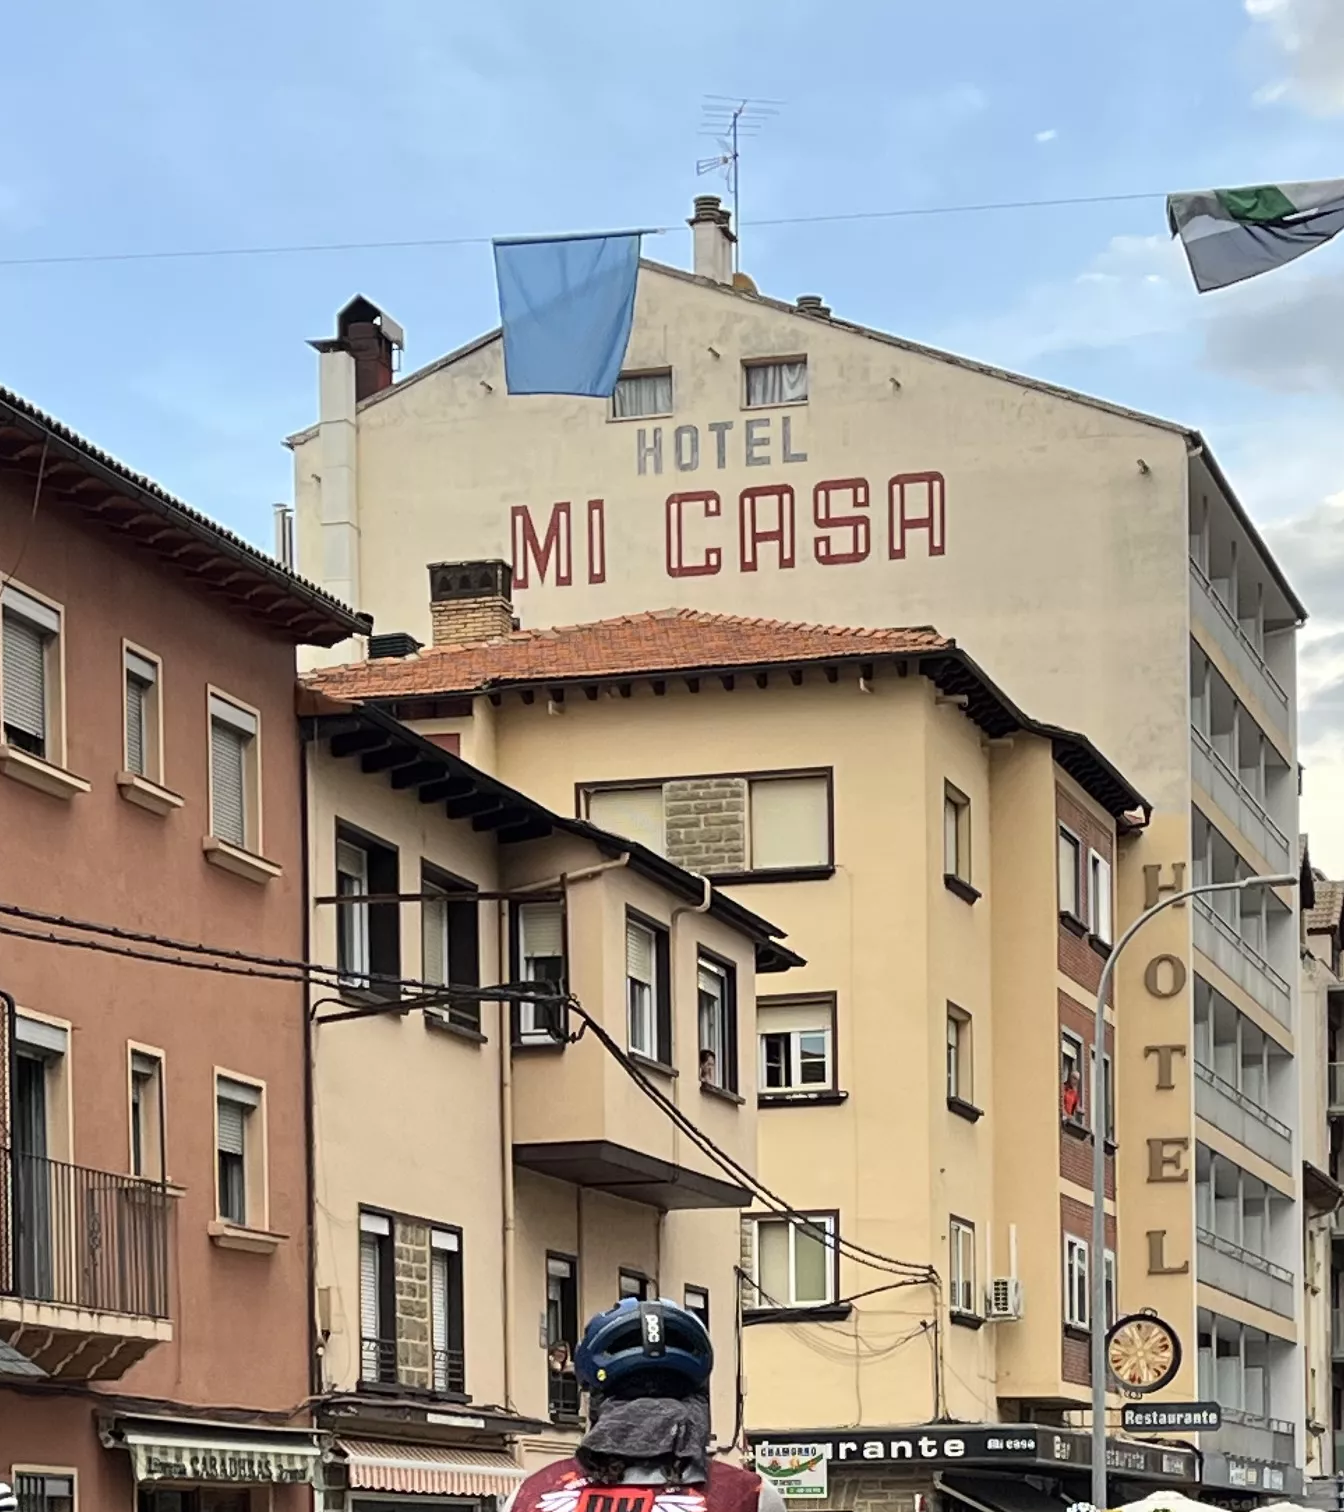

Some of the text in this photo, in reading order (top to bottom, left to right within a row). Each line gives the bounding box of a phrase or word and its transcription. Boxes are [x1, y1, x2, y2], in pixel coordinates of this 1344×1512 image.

[637, 416, 808, 476] HOTEL
[511, 471, 945, 589] MI CASA
[1143, 862, 1189, 1276] HOTEL
[1124, 1409, 1218, 1425] Restaurante
